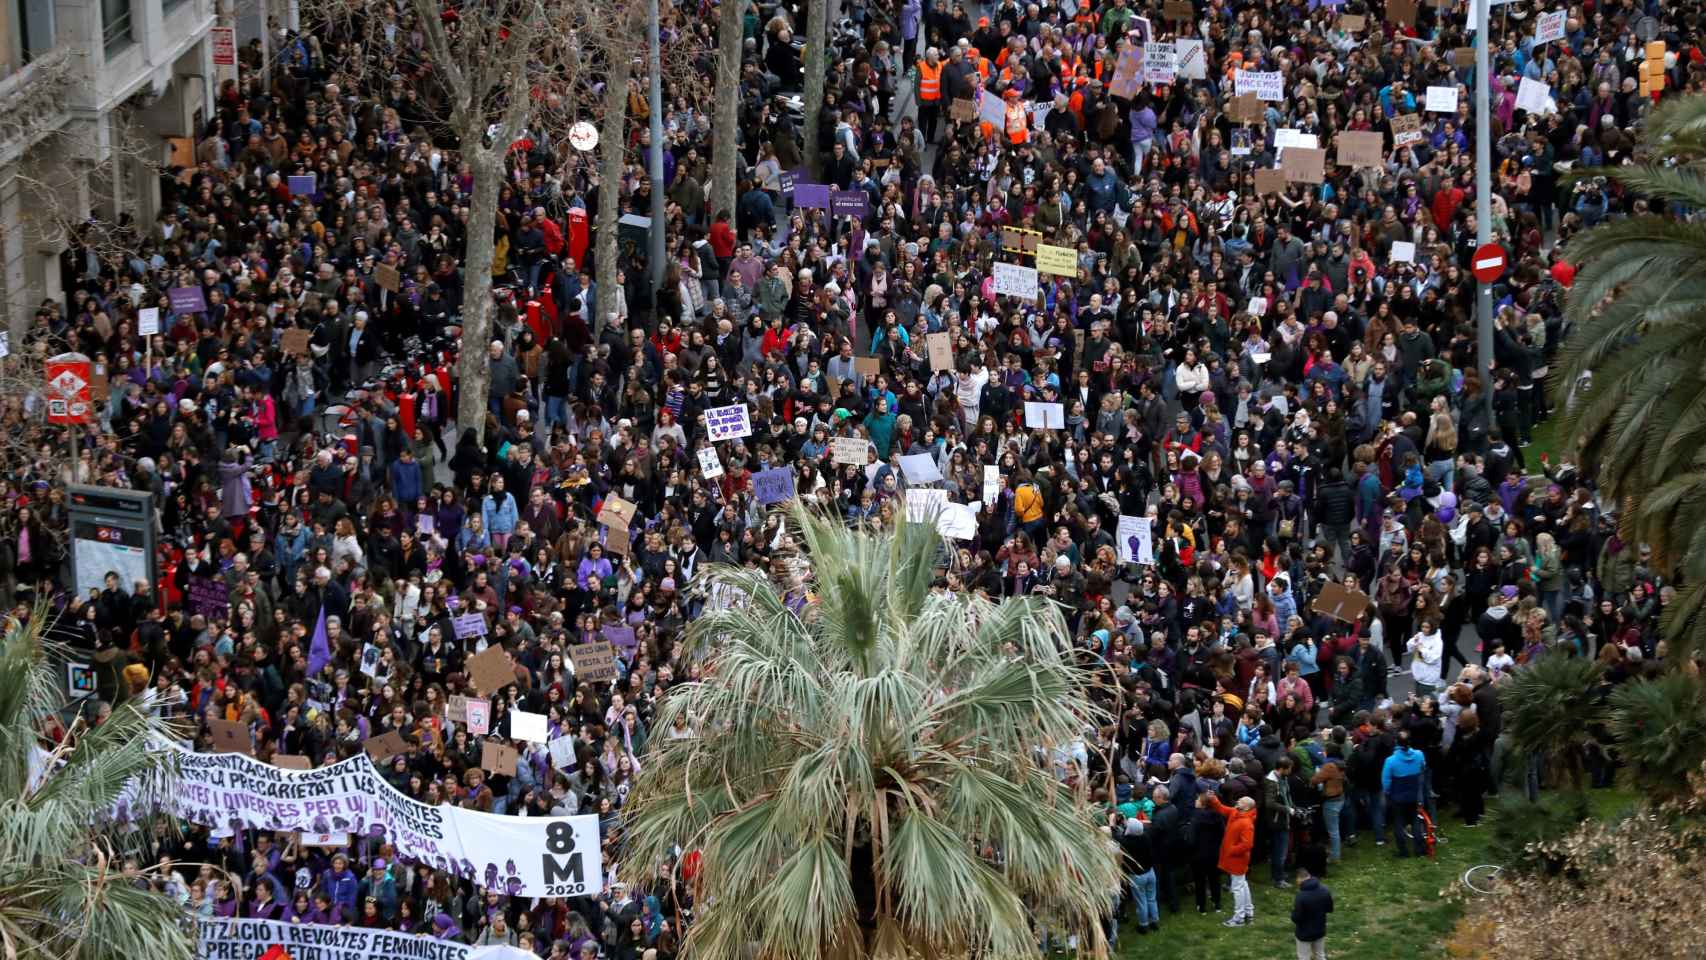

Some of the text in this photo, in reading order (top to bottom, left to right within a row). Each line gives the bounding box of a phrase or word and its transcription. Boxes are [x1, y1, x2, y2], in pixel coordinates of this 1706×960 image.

[229, 773, 334, 800] PRECARIETAT
[222, 791, 299, 818] DIVERSES
[303, 799, 340, 818] PER
[546, 821, 575, 854] 8
[542, 852, 585, 884] M
[545, 883, 585, 896] 2020
[277, 926, 284, 941] I
[289, 926, 368, 949] REVOLTES
[372, 934, 468, 960] FEMINISTES
